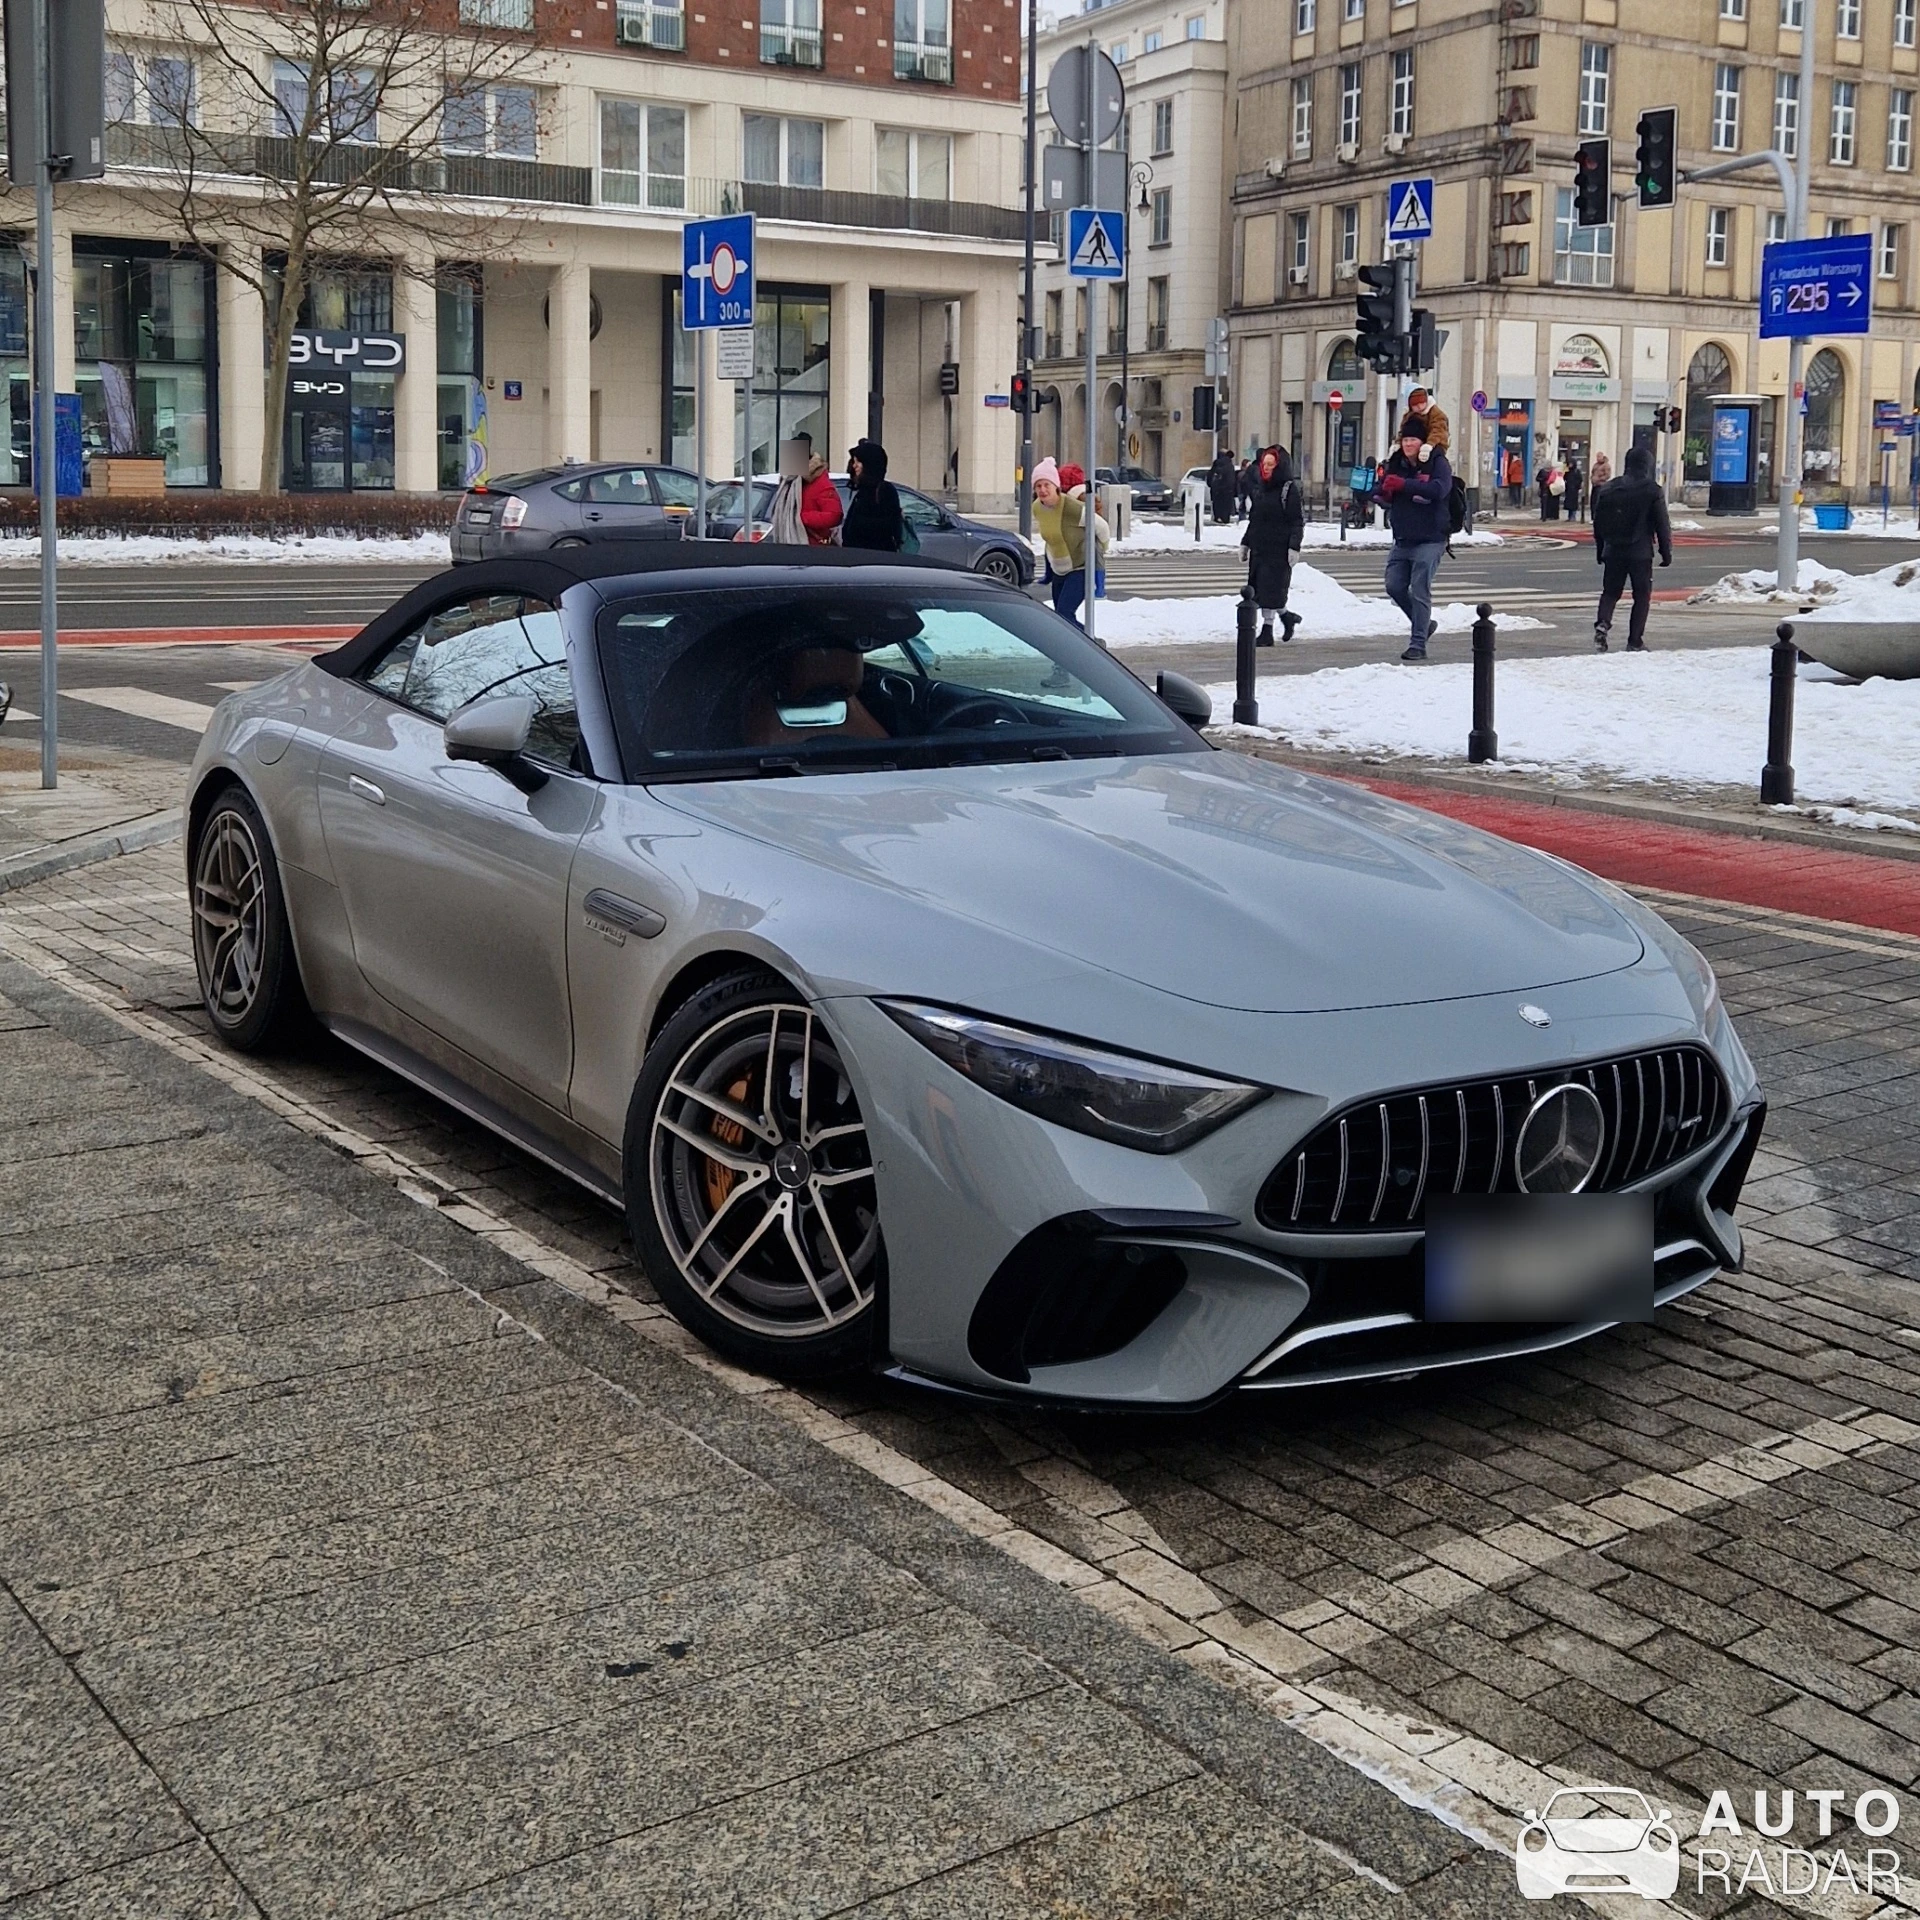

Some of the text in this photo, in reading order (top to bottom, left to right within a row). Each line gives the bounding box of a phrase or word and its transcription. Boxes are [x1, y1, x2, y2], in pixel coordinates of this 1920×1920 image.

[1821, 263, 1863, 278] Warszawy
[1787, 281, 1830, 313] 295
[719, 302, 751, 321] 300 m
[1572, 339, 1592, 347] SALON
[289, 334, 403, 367] BYD
[1562, 347, 1600, 355] MODELARSKI
[293, 381, 345, 394] BYD
[508, 385, 519, 396] 16
